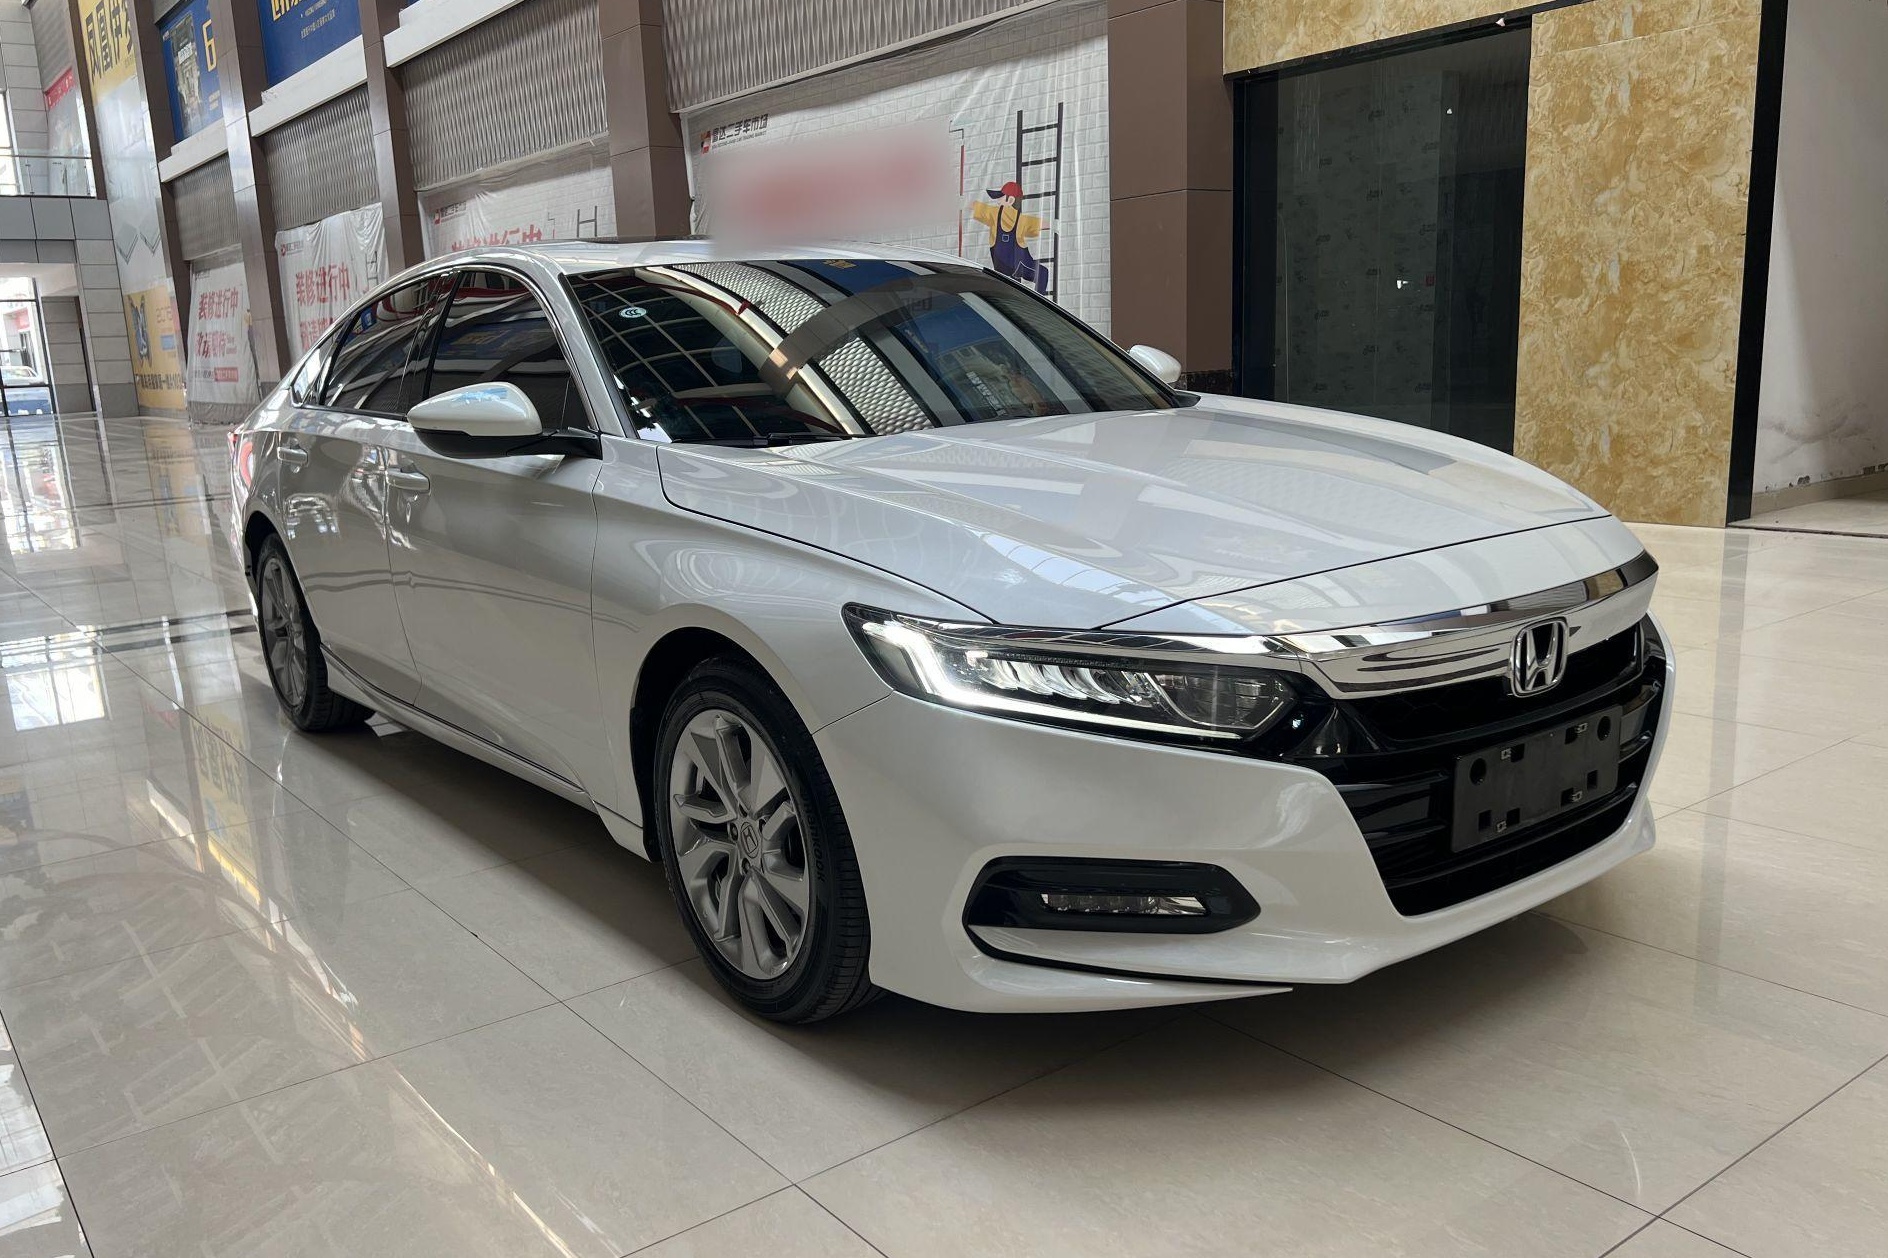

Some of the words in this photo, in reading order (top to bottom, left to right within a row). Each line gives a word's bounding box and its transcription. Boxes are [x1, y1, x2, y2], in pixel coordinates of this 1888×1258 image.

[199, 287, 239, 320] 装修进行中
[295, 262, 350, 307] 装修进行中
